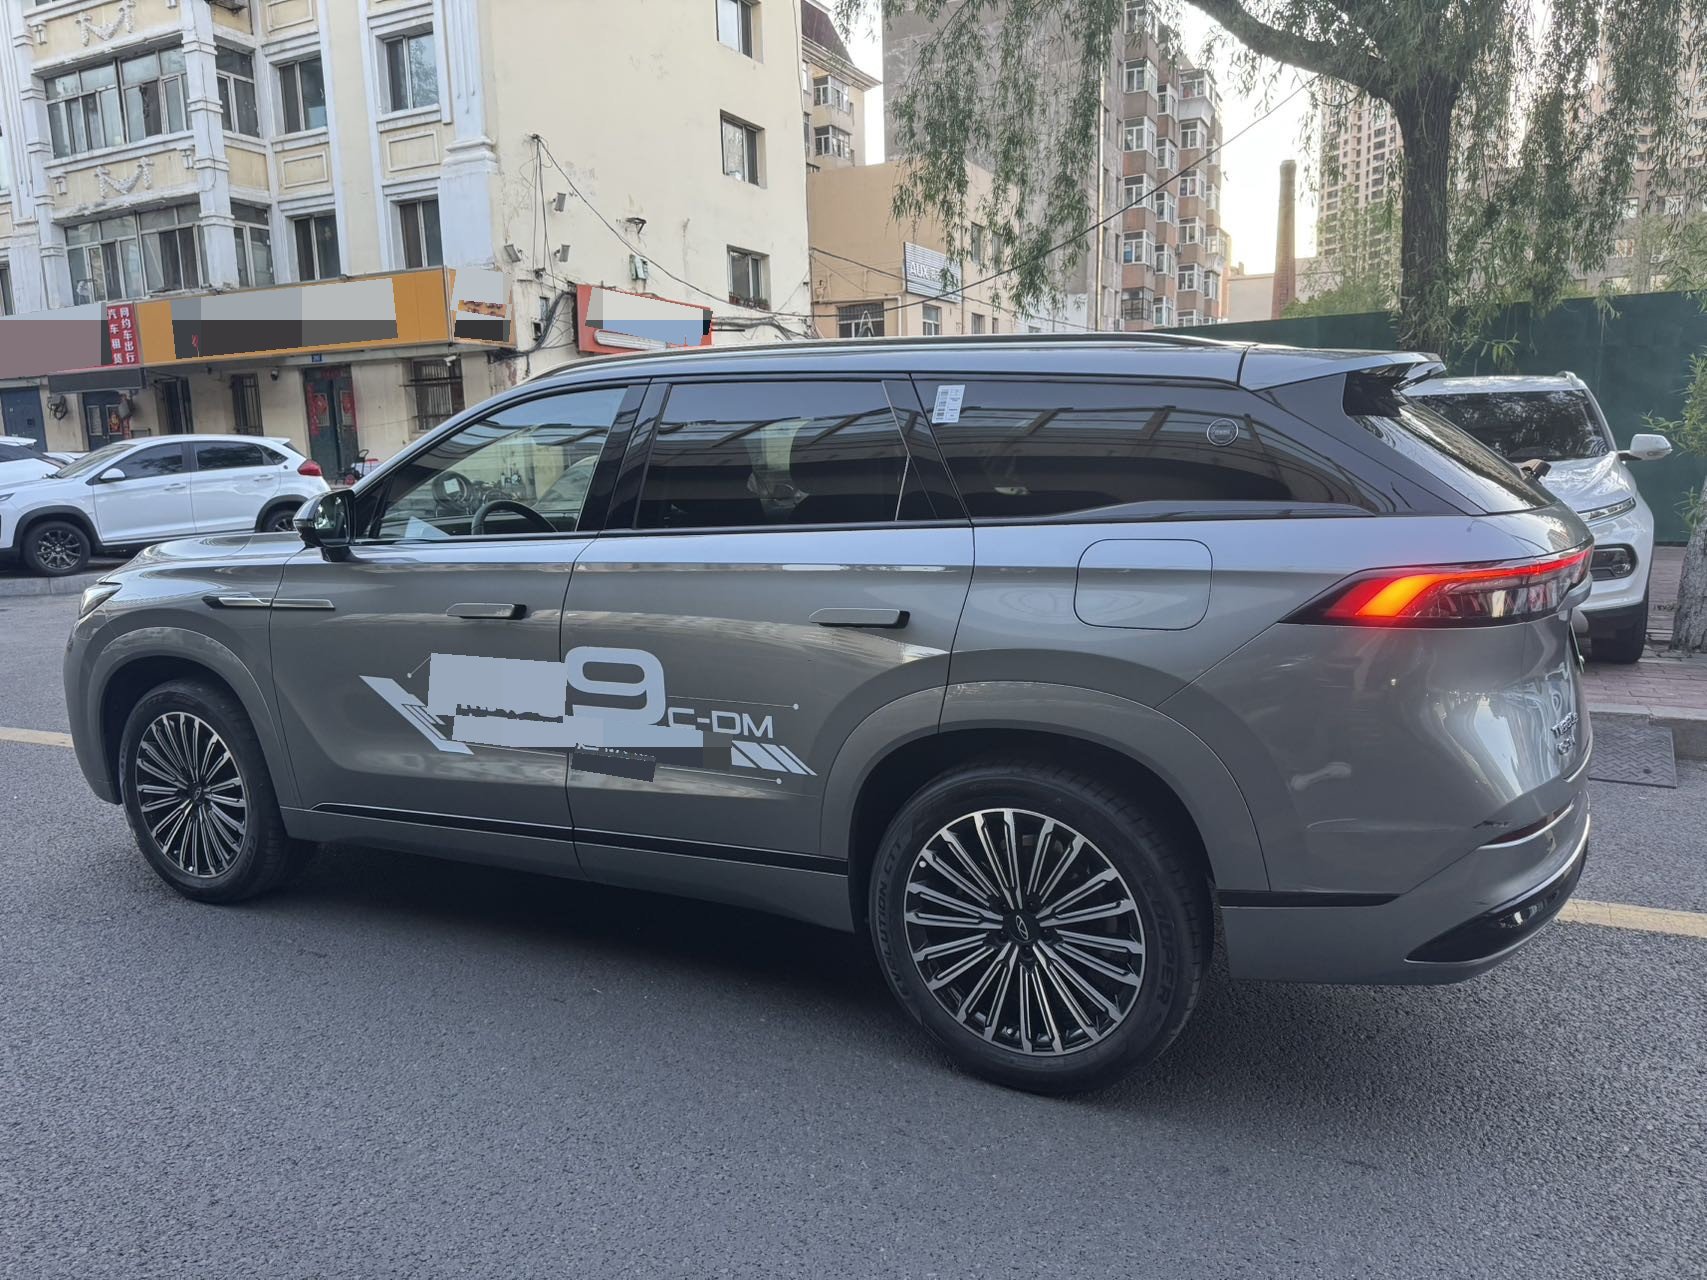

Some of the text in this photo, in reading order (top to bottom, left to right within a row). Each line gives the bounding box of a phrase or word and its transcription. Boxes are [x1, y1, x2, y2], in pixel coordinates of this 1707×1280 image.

[910, 261, 929, 280] AUX
[107, 308, 123, 364] 汽车租赁
[120, 307, 135, 363] 网约车出行
[667, 706, 774, 739] C-DM
